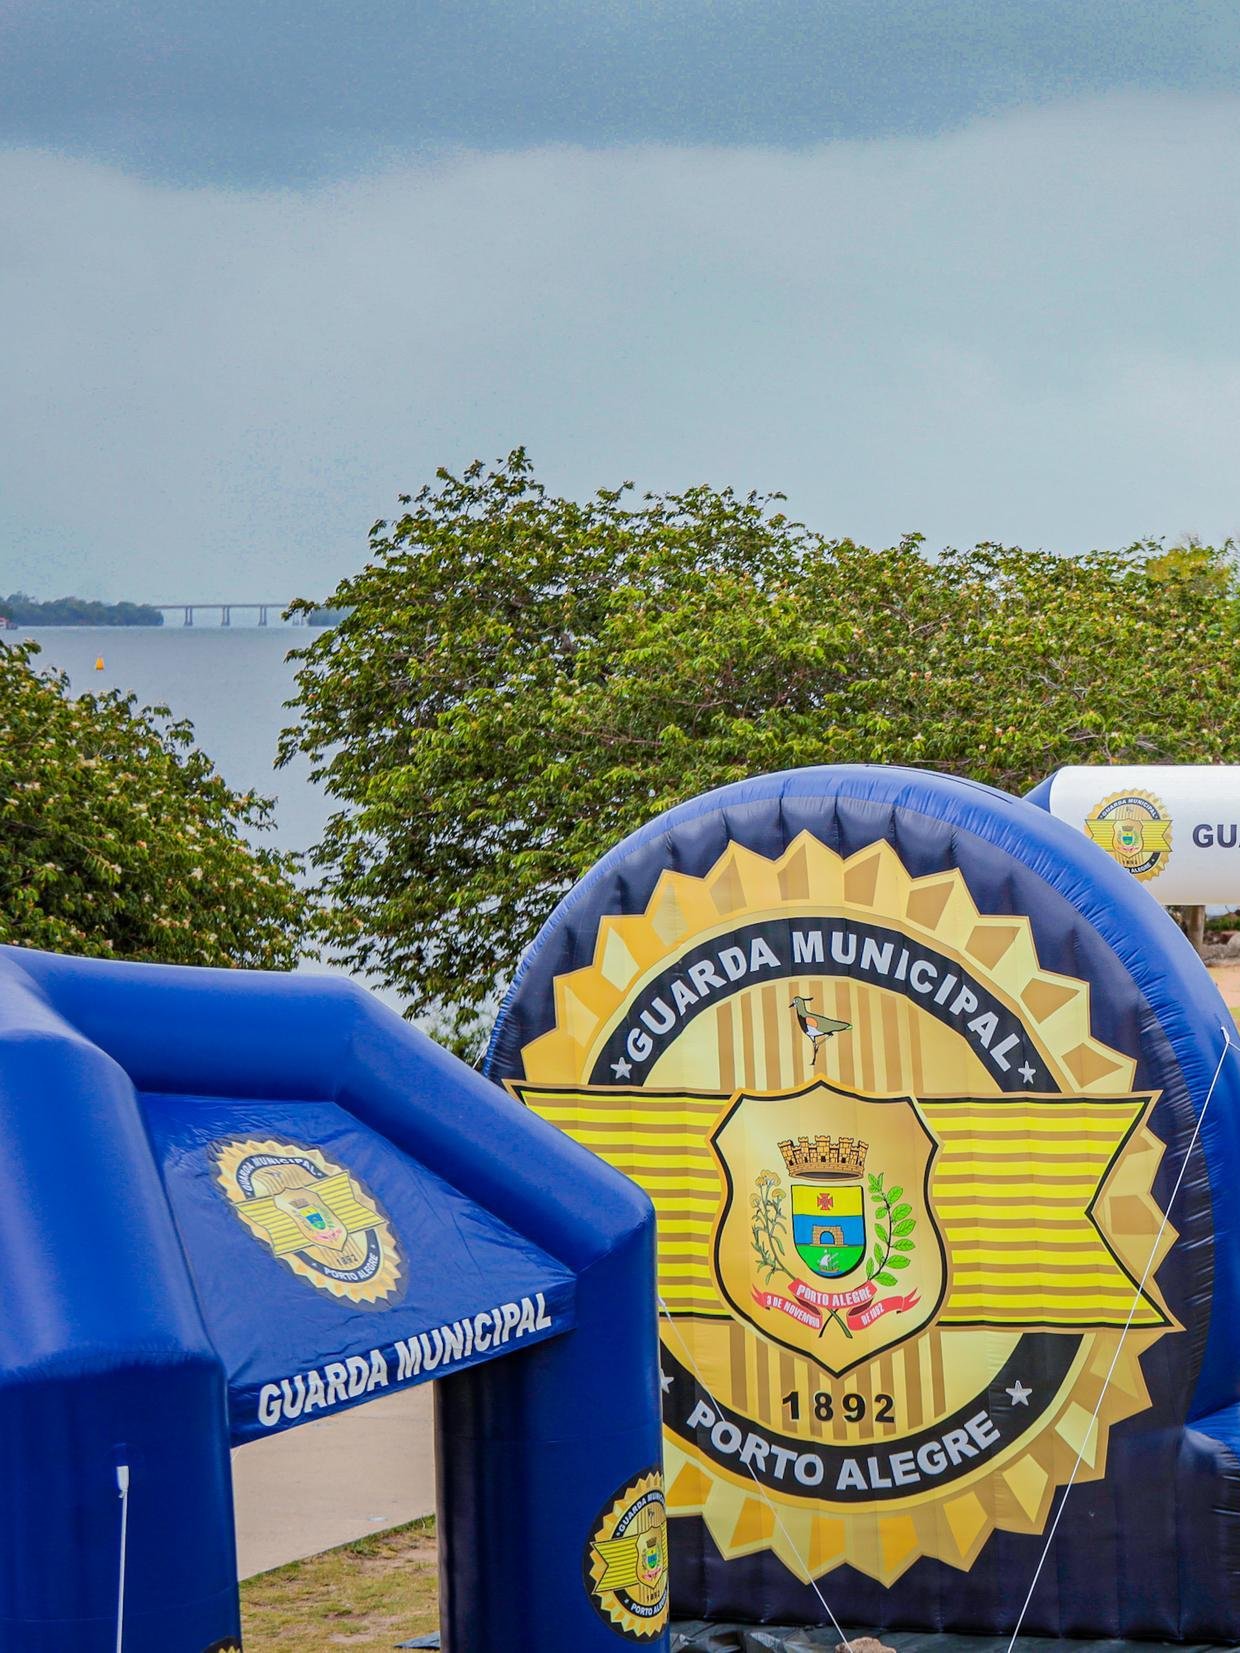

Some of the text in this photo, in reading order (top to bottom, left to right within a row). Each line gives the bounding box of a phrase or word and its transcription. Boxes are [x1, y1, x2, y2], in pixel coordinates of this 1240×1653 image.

[623, 930, 1020, 1073] GUARDA MUNICIPAL
[324, 1254, 378, 1281] PORTO ALEGRE
[796, 1284, 872, 1306] PORTO ALEGRE
[257, 1292, 552, 1428] GUARDA MUNICIPAL
[782, 1391, 895, 1423] 1892
[686, 1399, 1000, 1491] PORTO ALEGRE
[618, 1497, 647, 1532] GUARDA
[631, 1603, 653, 1616] PORTO
